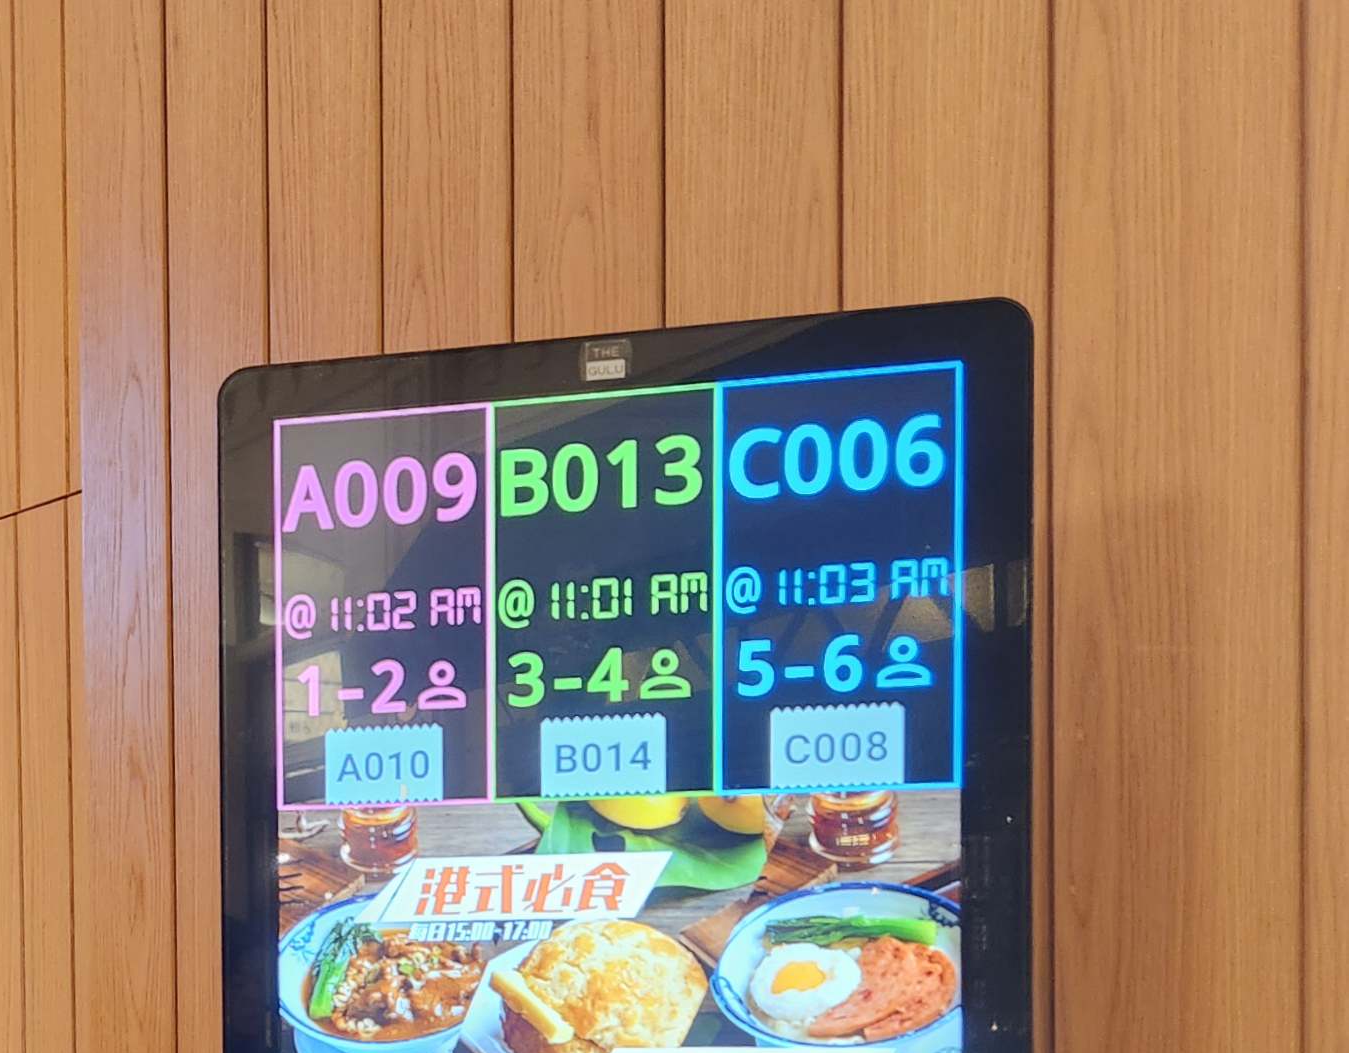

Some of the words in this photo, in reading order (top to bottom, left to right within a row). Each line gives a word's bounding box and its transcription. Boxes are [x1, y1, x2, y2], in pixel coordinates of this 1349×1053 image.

[588, 364, 624, 377] GULU
[592, 346, 620, 359] THE
[500, 434, 704, 517] B013
[729, 414, 946, 499] C006
[282, 451, 478, 533] A009
[284, 594, 316, 640] @
[330, 590, 416, 633] 11:02
[430, 586, 482, 626] AM
[499, 579, 535, 629] @
[551, 577, 632, 621] 11:01
[651, 572, 708, 614] AM
[726, 566, 762, 615] @
[778, 561, 877, 606] 11:03
[891, 557, 949, 599] AM
[297, 659, 407, 717] 1-2
[508, 647, 629, 708] 3-4
[737, 634, 864, 697] 5-6
[337, 750, 430, 783] A010
[555, 741, 652, 774] B014
[784, 731, 889, 765] C008
[414, 862, 630, 916] 港式必食
